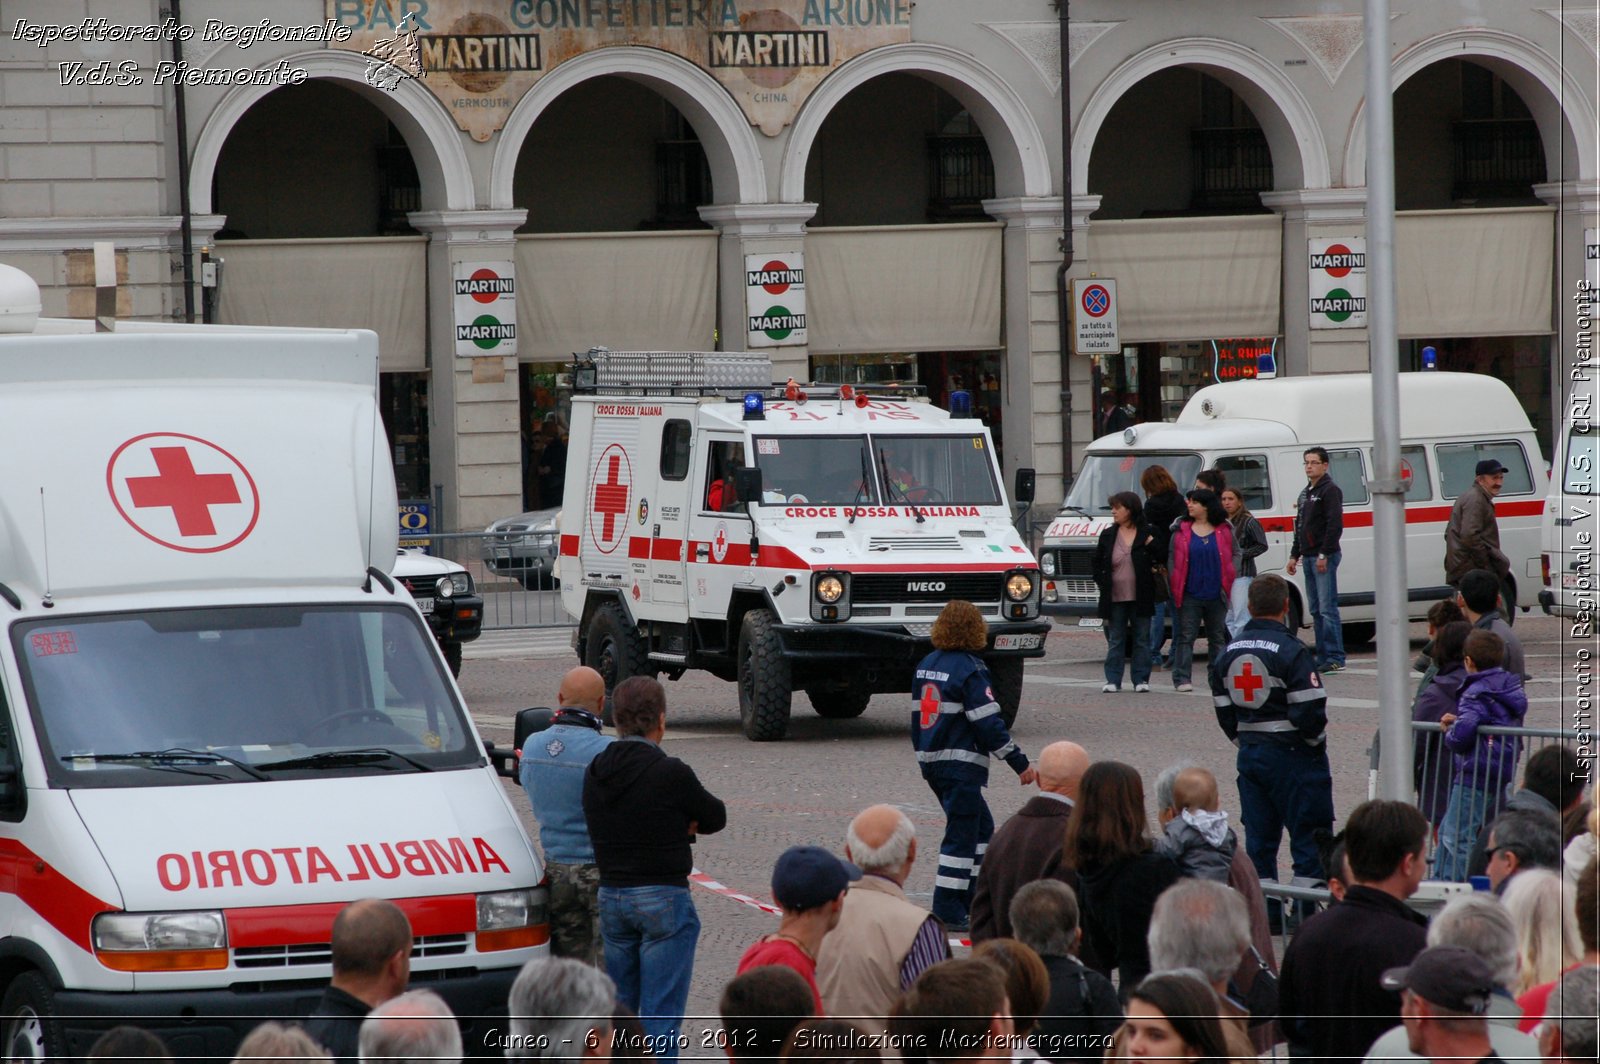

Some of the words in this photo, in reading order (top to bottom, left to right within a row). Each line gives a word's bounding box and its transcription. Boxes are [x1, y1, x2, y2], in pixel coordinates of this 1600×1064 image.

[337, 0, 431, 30] BAR
[420, 37, 537, 70] MARTINI
[713, 33, 825, 65] MARTINI
[452, 97, 511, 109] VERMOUTH
[754, 92, 788, 103] CHINA
[1312, 254, 1364, 267] MARTINI
[749, 270, 803, 284] MARTINI
[457, 279, 513, 293] MARTINI
[1312, 299, 1365, 312] MARTINI
[750, 315, 805, 330] MARTINI
[458, 325, 514, 339] MARTINI
[1086, 340, 1109, 348] rialzato
[597, 405, 616, 415] CROCE
[616, 405, 636, 416] ROSSA
[785, 507, 838, 518] CROCE
[843, 507, 899, 517] ROSSA
[904, 506, 980, 517] ITALIANA
[907, 581, 946, 592] IVECO
